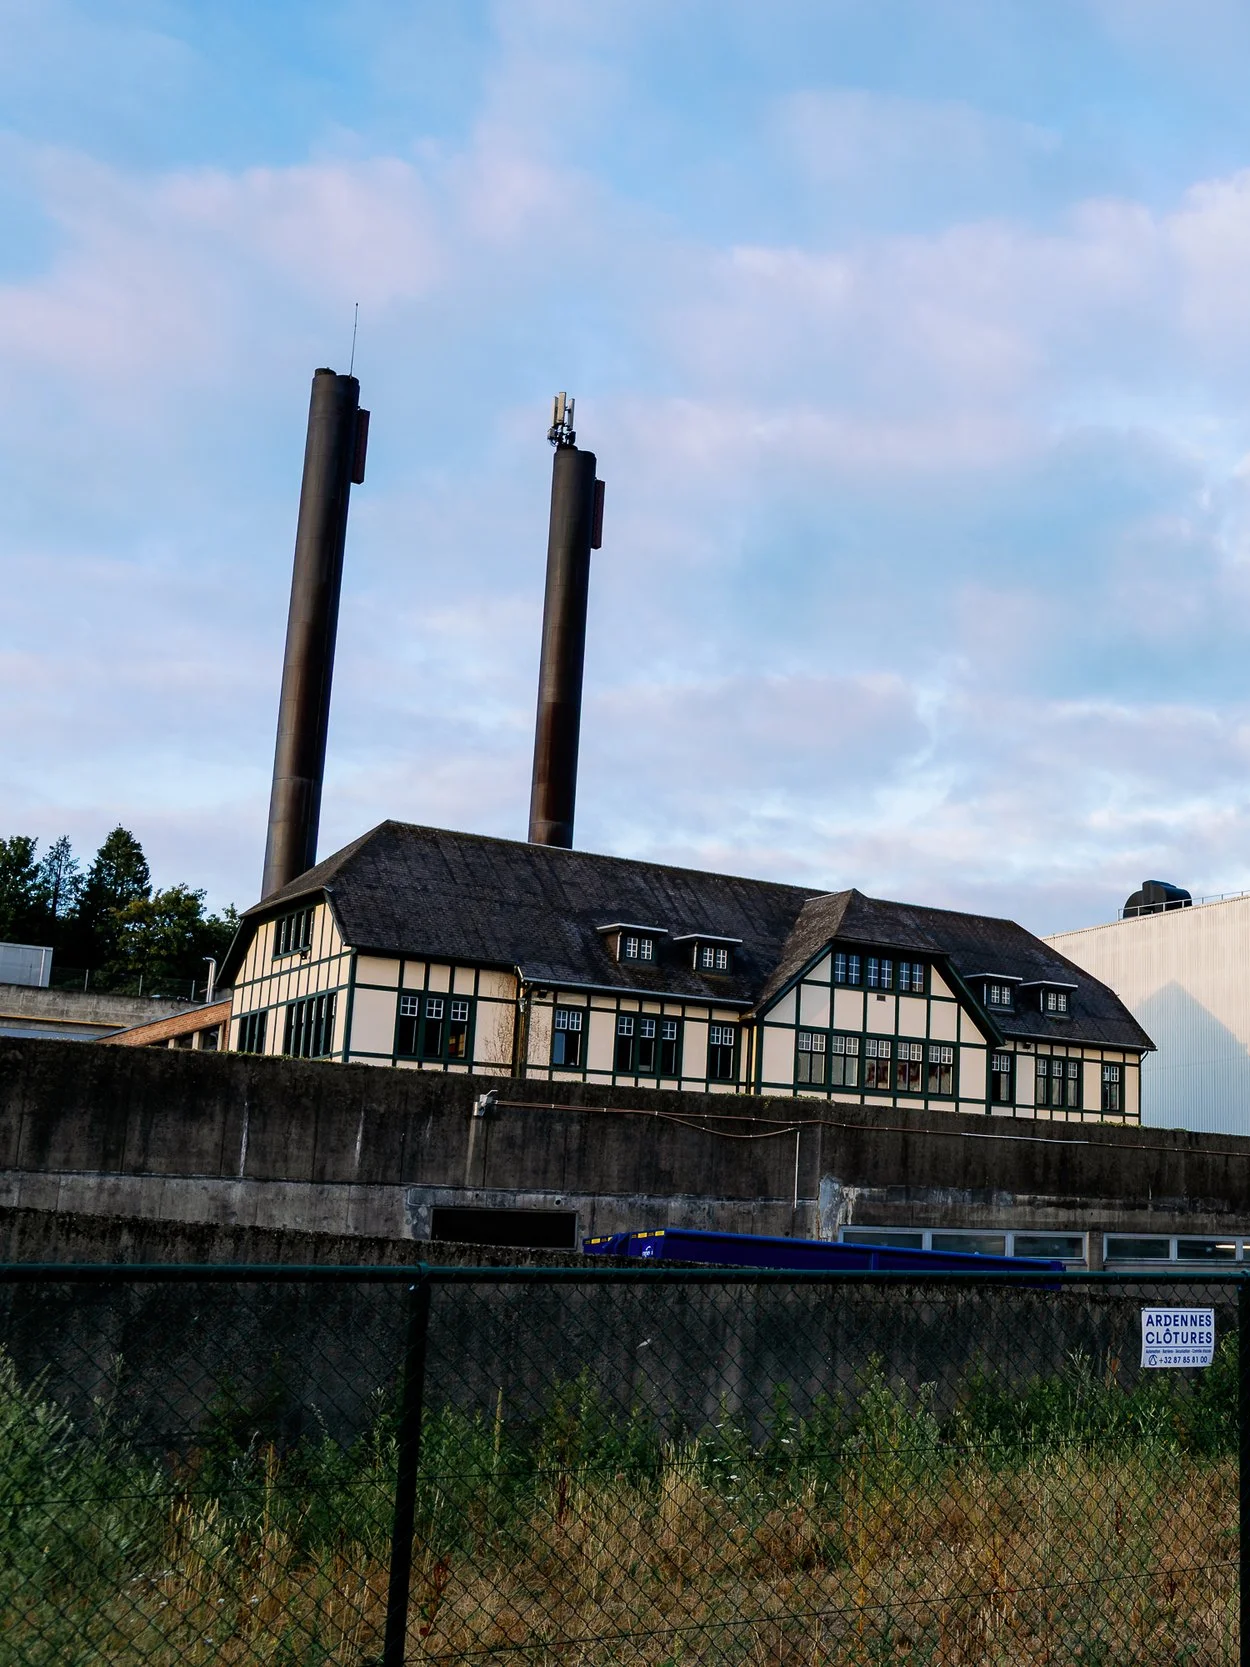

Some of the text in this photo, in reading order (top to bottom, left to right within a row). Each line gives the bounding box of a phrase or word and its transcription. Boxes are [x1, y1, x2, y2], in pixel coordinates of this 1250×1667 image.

[1146, 1314, 1212, 1327] ARDENNES
[1145, 1328, 1212, 1344] CLÔTURES
[1159, 1356, 1172, 1364] +32
[1173, 1356, 1181, 1364] 87
